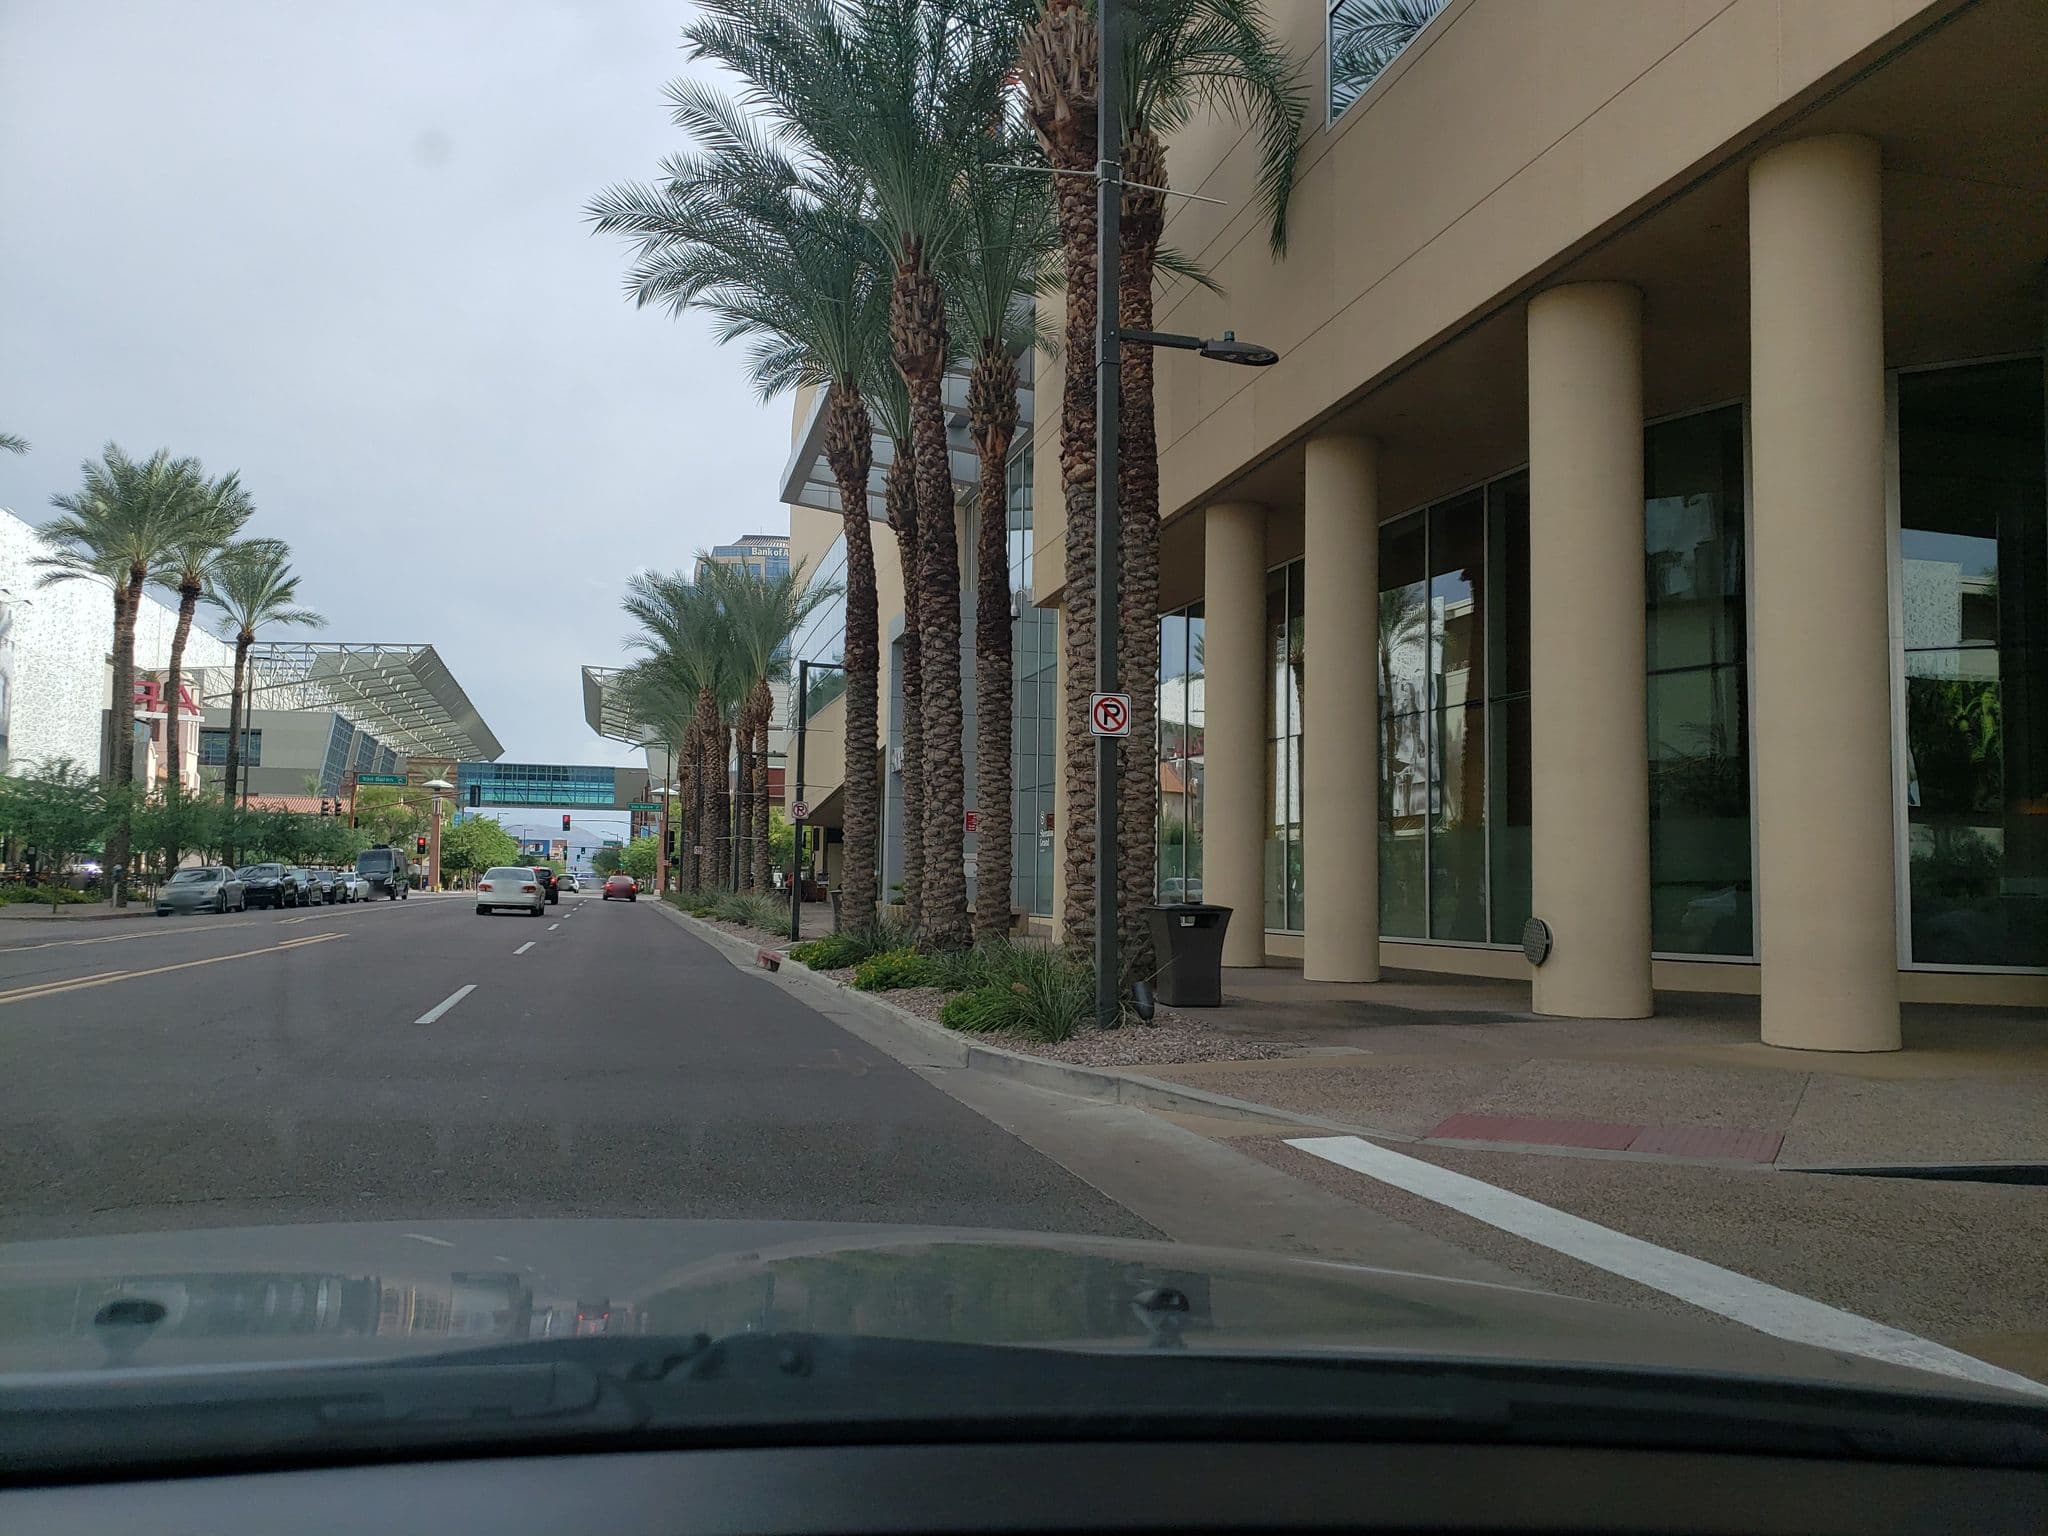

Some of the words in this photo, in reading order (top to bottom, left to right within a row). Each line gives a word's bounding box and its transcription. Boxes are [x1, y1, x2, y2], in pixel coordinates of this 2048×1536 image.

[751, 547, 773, 556] Bank
[774, 548, 782, 556] of
[1103, 703, 1121, 726] P
